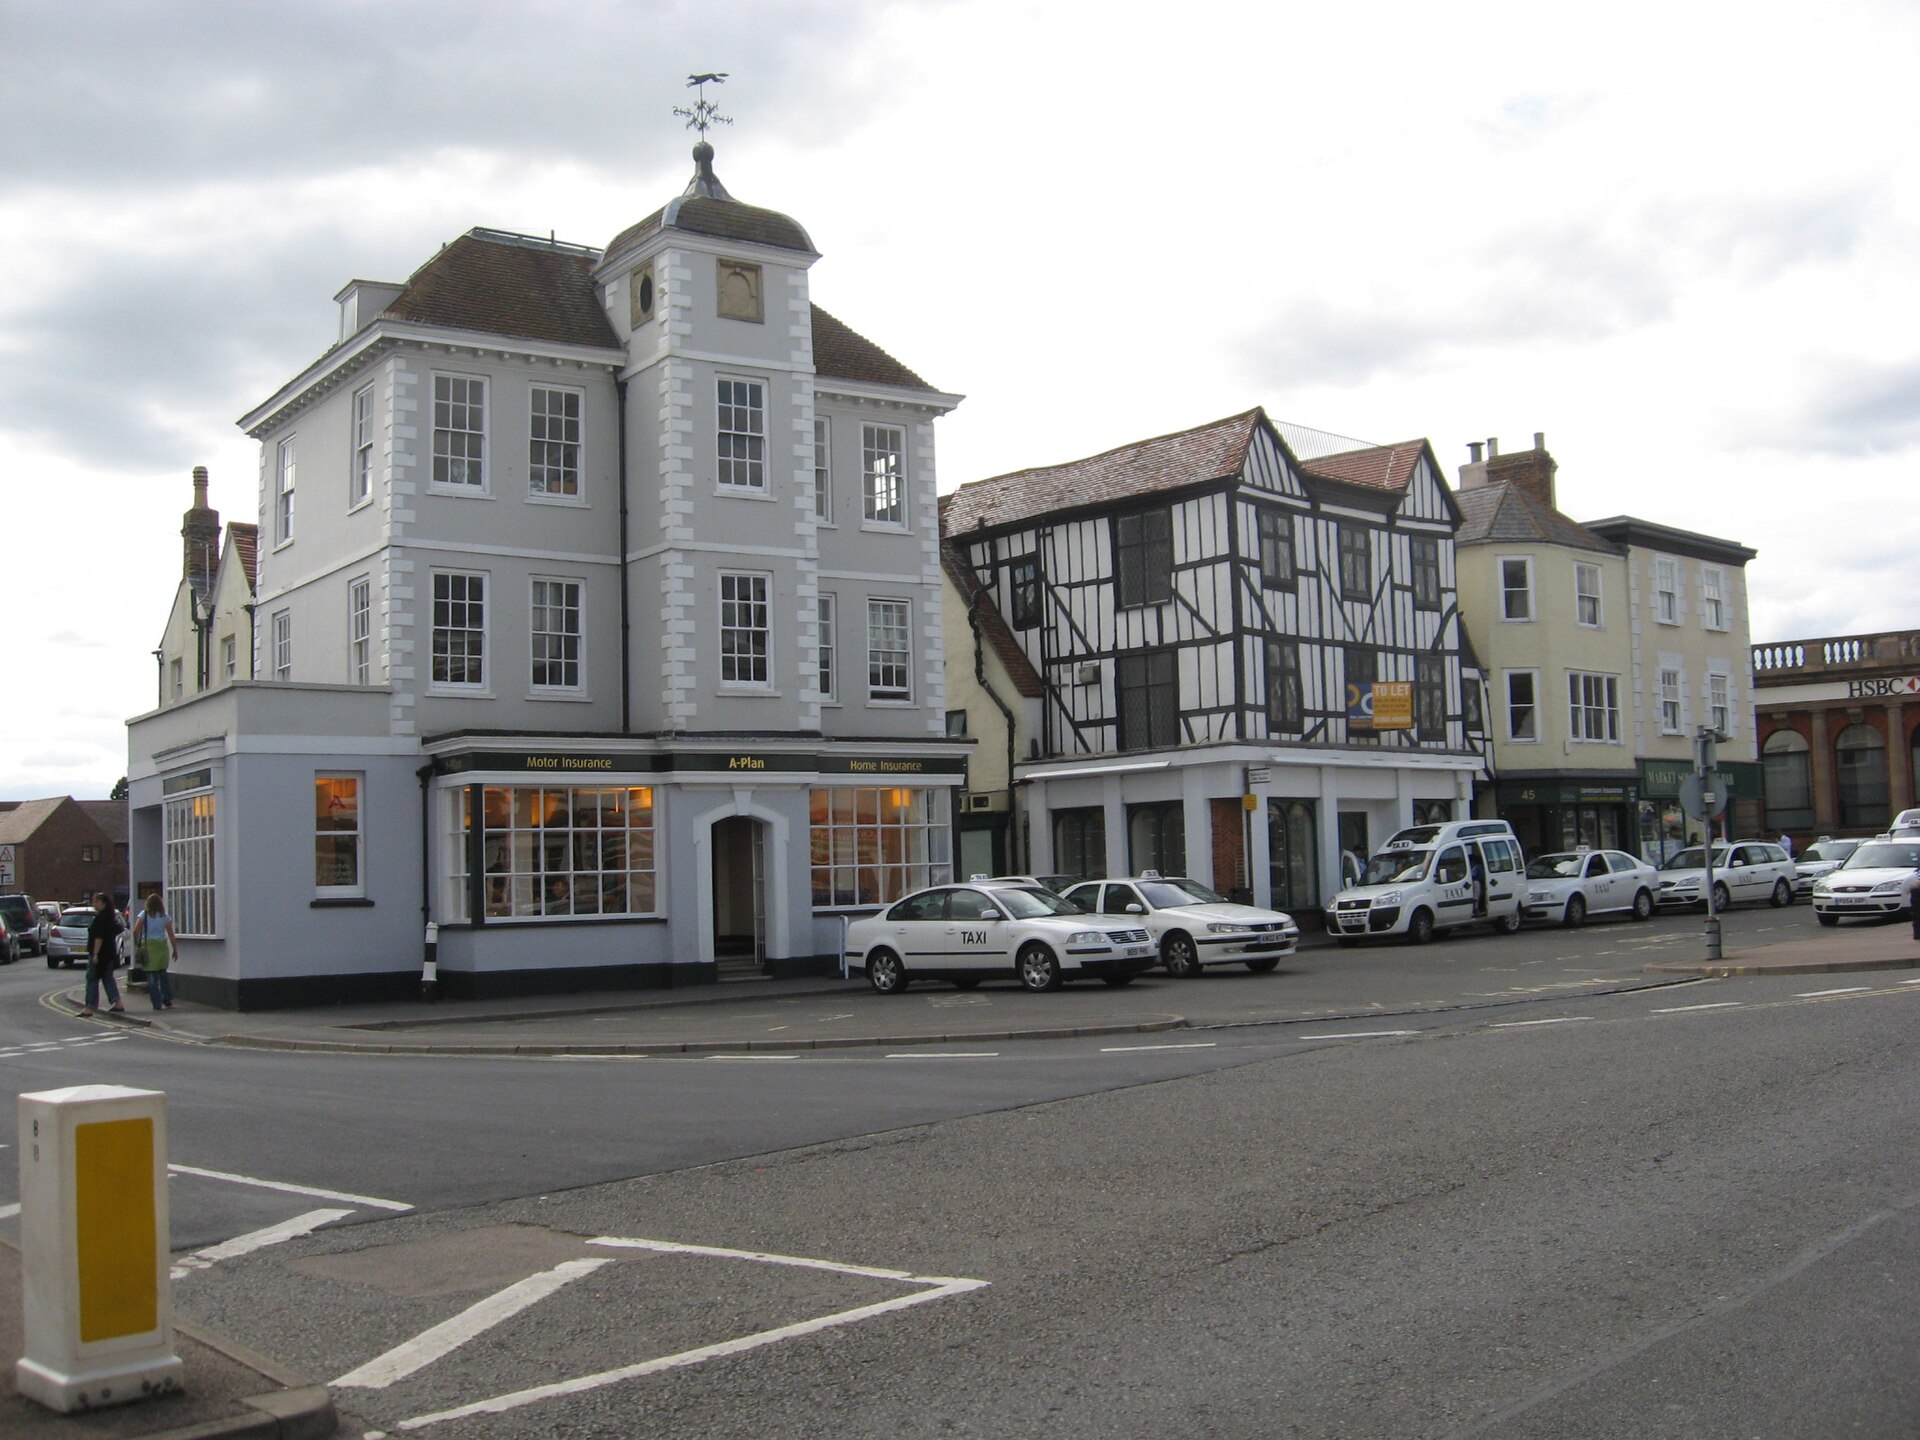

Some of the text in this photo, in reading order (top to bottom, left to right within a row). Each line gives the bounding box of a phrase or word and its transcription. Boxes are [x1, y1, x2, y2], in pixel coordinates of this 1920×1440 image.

[1374, 684, 1410, 697] TO LET
[1848, 677, 1904, 698] HSBC
[526, 756, 612, 769] Motor Insurance
[728, 756, 765, 769] A-Plan
[850, 760, 922, 771] Home Insurance
[1648, 771, 1676, 785] MARKET
[1521, 789, 1536, 800] 45
[1393, 841, 1410, 849] TAXI
[1444, 888, 1464, 900] TAXI
[1594, 883, 1610, 894] TAXI
[961, 931, 987, 945] TAXI
